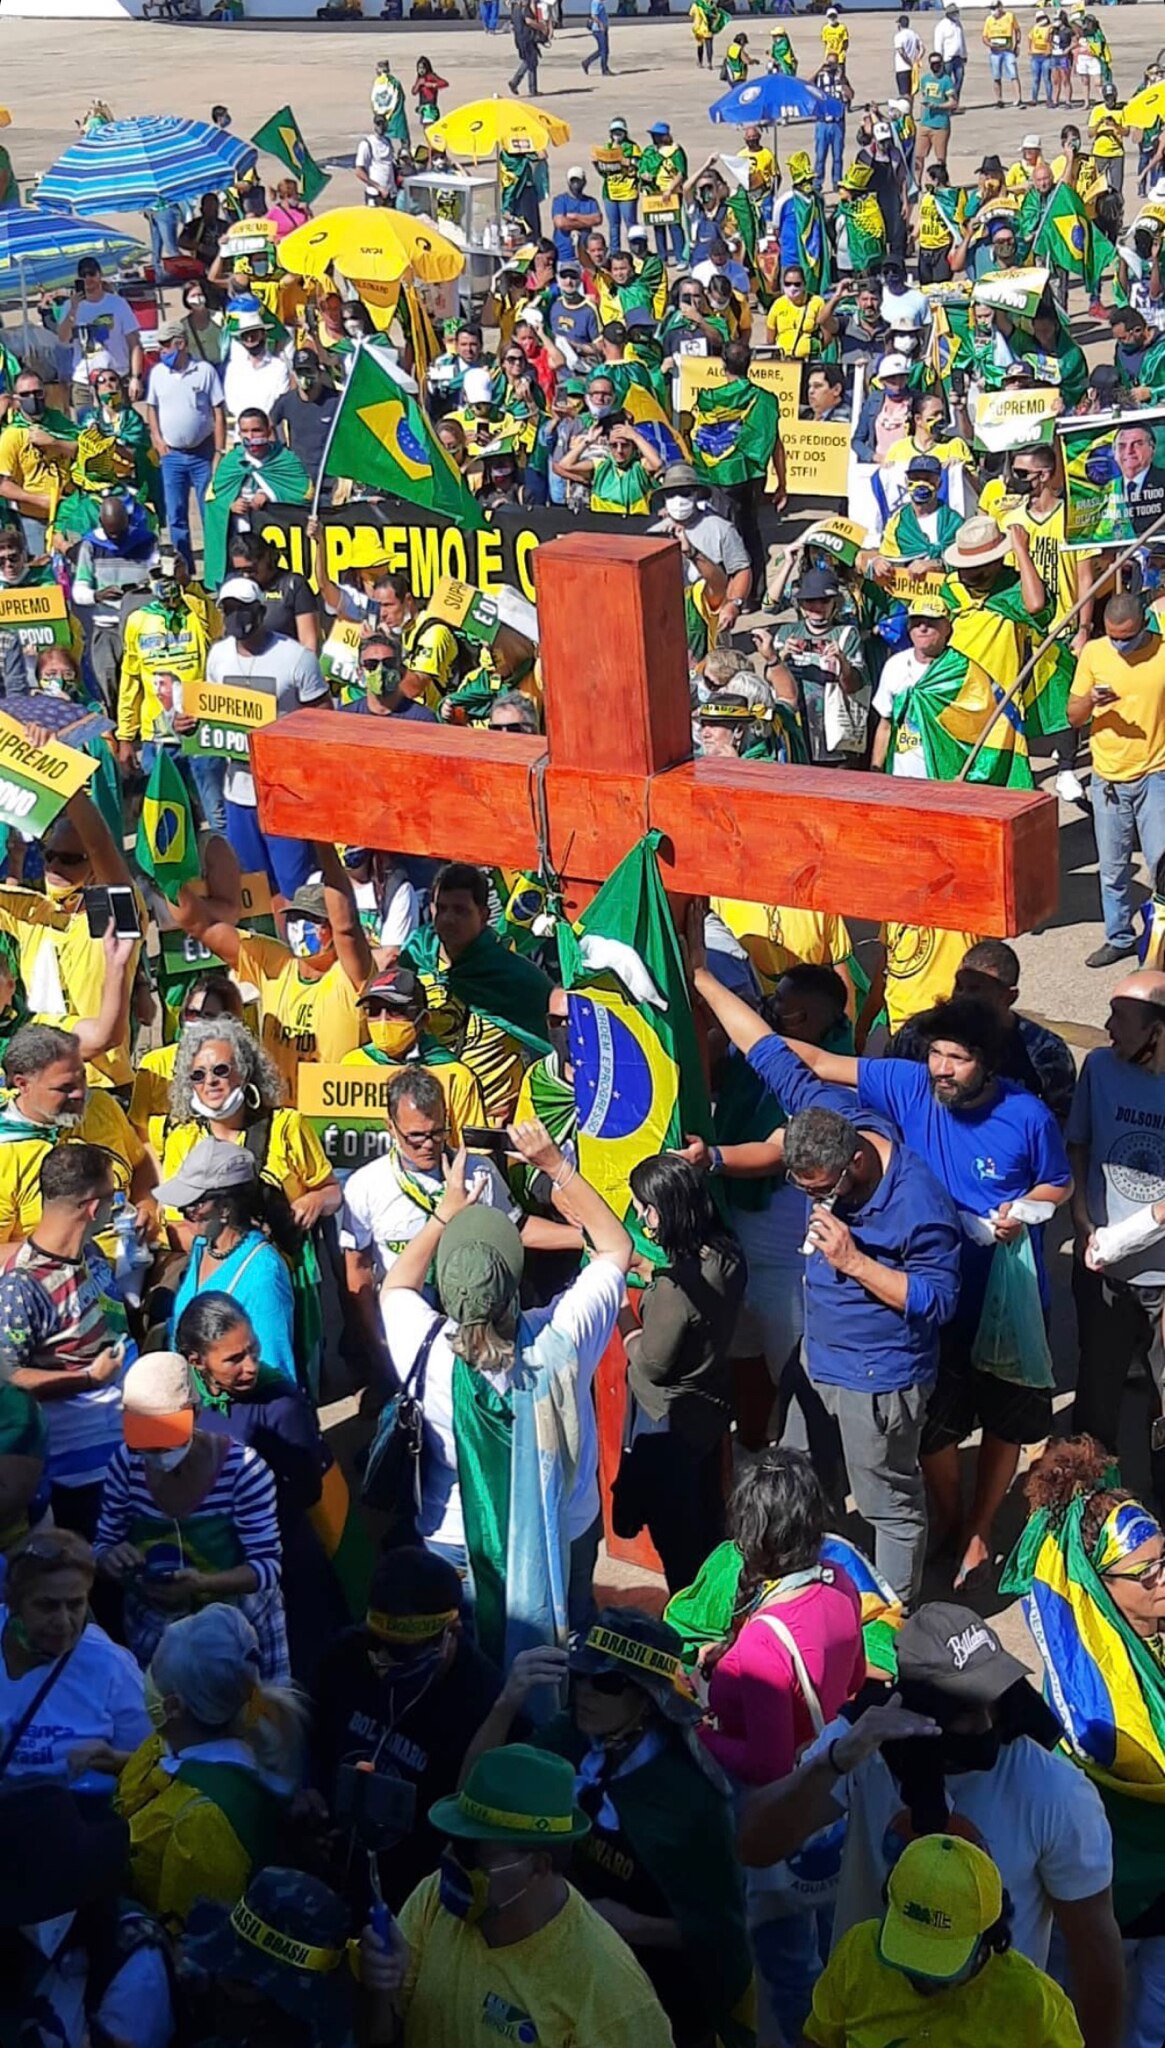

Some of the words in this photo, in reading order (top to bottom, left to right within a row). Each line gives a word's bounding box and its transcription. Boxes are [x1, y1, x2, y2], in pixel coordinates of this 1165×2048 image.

[800, 434, 847, 446] PEDIDOS
[803, 451, 826, 462] DOS
[1143, 487, 1164, 500] TUDO
[1136, 503, 1162, 516] TODOS
[261, 525, 467, 598] SUPEMO
[0, 597, 51, 616] UPREMO
[19, 627, 54, 645] POVO
[199, 693, 263, 721] SUPREMO
[201, 724, 211, 747] É
[213, 728, 224, 749] O
[0, 727, 69, 780] UPREMO
[597, 1007, 612, 1051] ORDEM
[323, 1081, 388, 1107] SUPRE
[587, 1065, 611, 1133] PROGRESSO
[324, 1124, 338, 1157] É
[344, 1130, 357, 1157] O
[364, 1131, 391, 1157] PO
[599, 1630, 648, 1664] BRASIL
[263, 1930, 310, 1964] BRASIL
